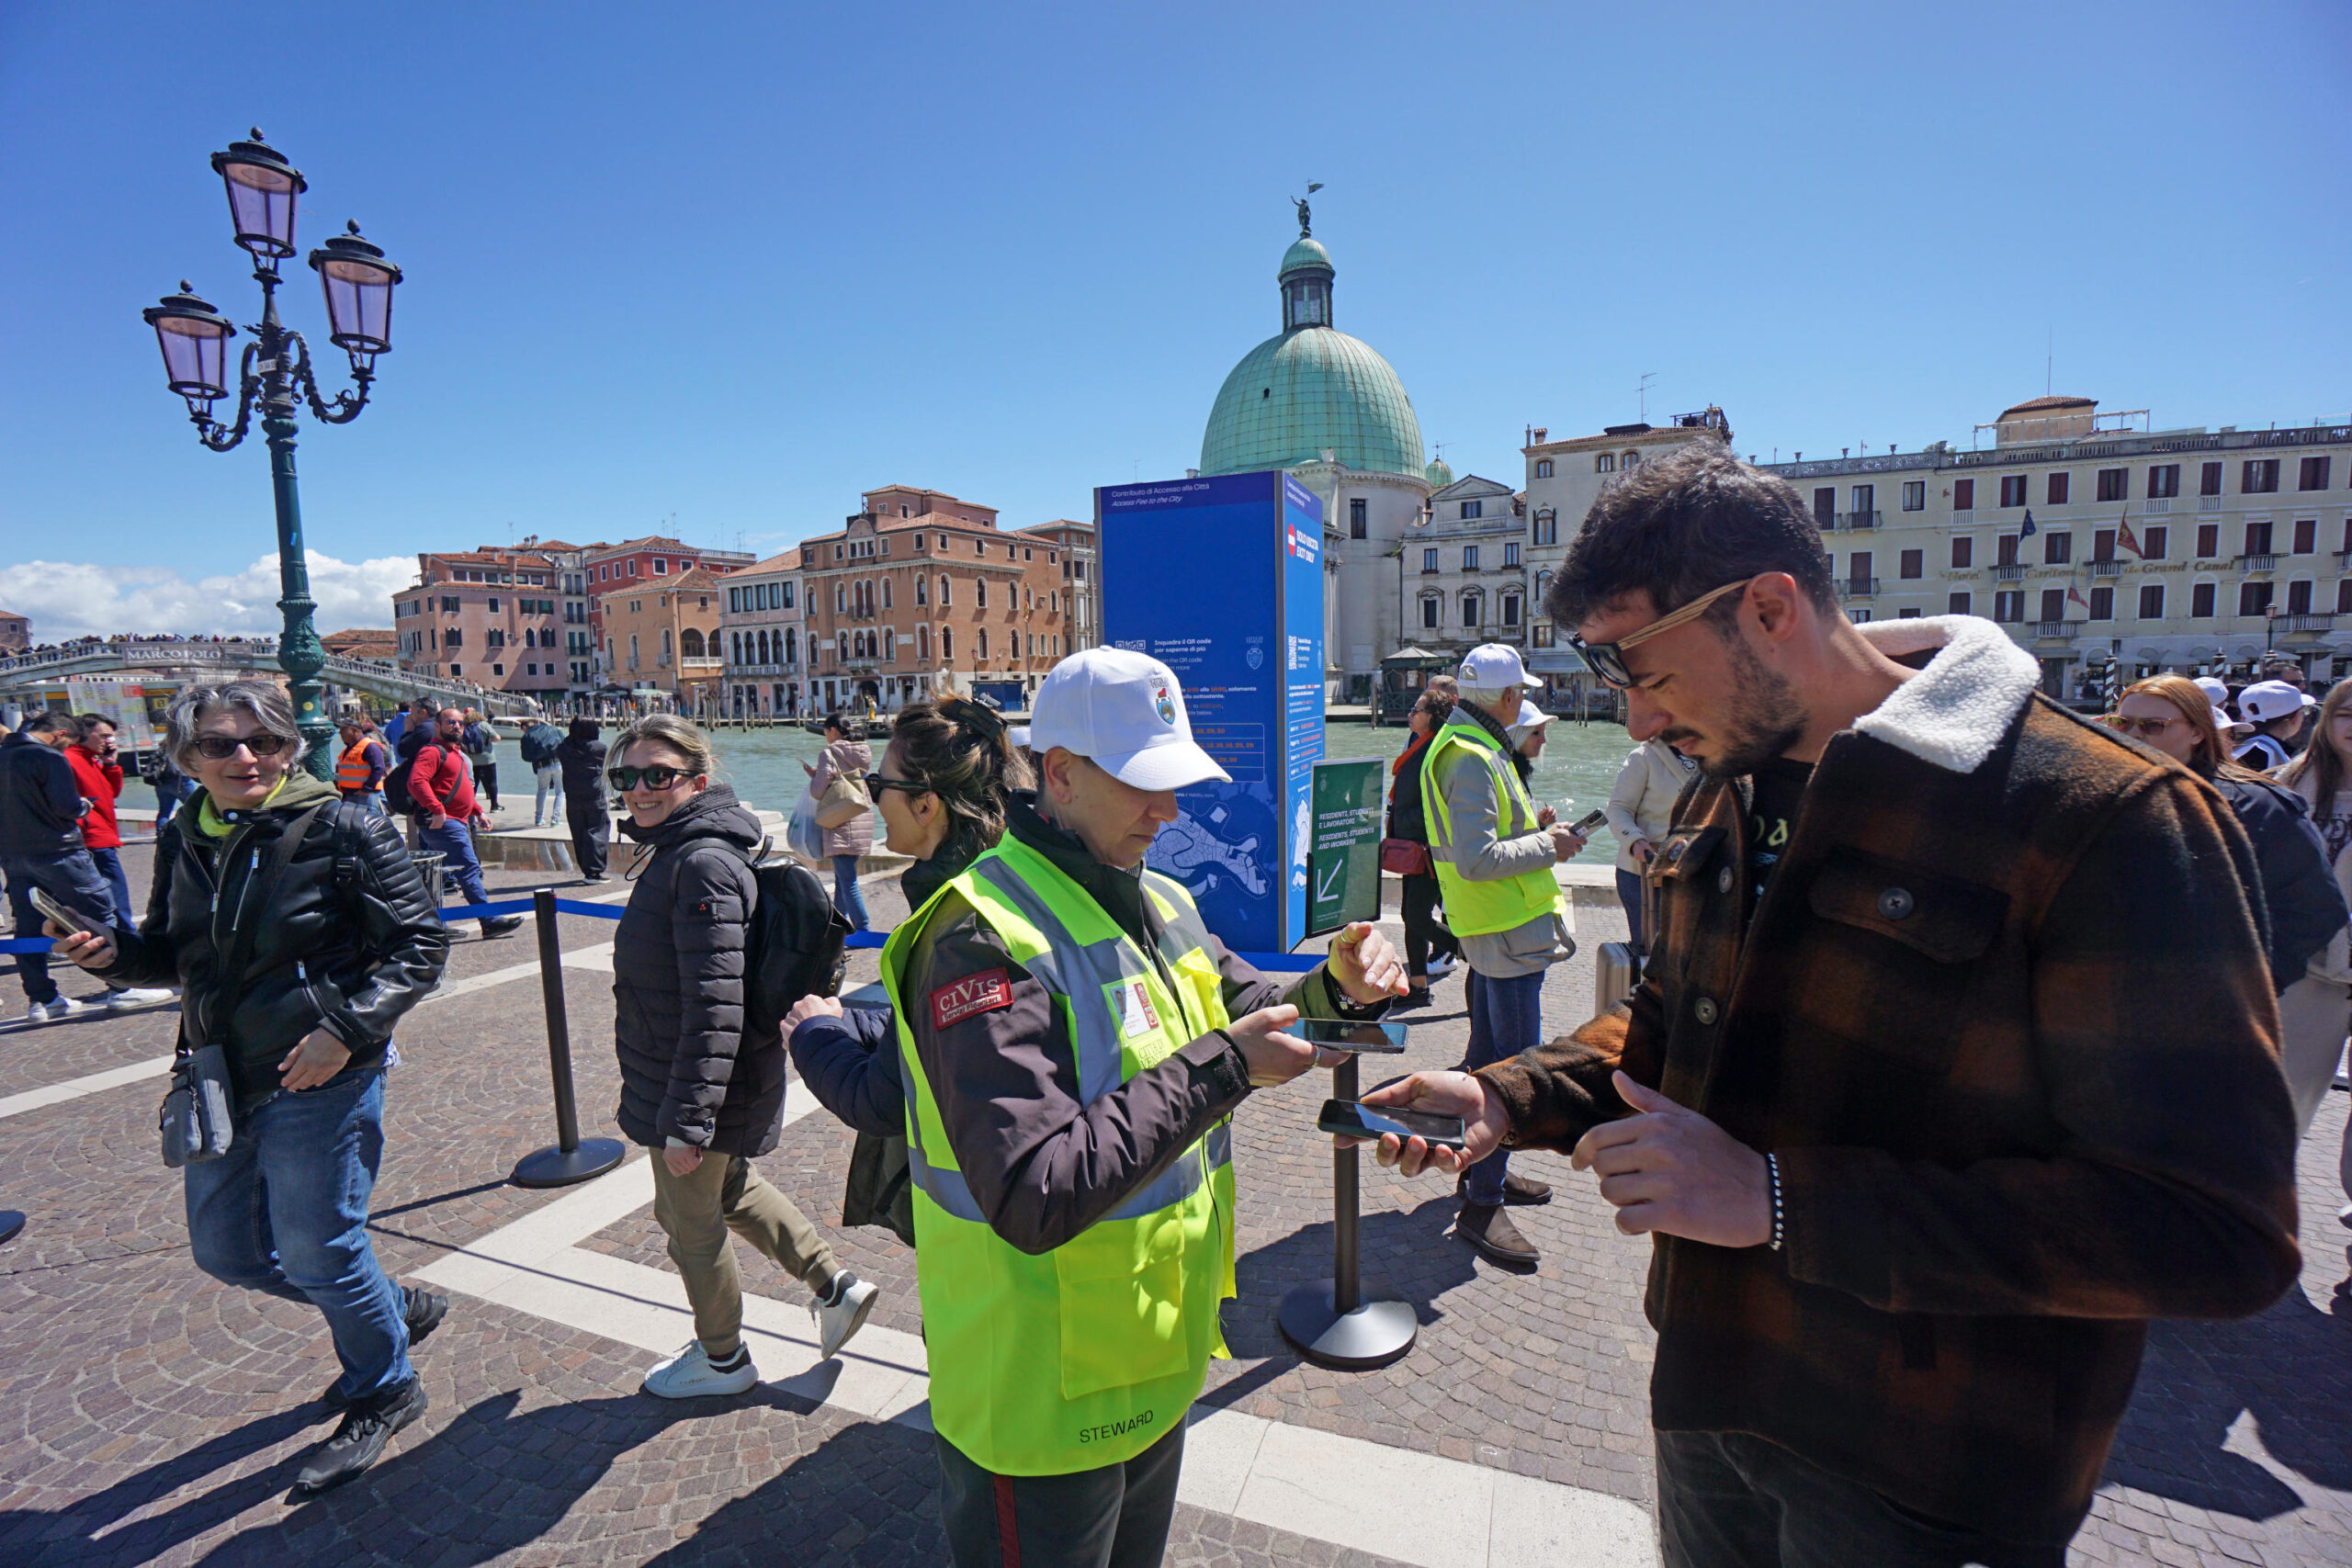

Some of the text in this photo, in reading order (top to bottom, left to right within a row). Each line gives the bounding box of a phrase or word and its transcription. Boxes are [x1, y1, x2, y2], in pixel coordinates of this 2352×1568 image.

[1112, 490, 1146, 498] Contributo
[1154, 486, 1181, 494] Accesso
[1112, 499, 1135, 507] Access
[1136, 497, 1148, 505] Fee
[1169, 495, 1183, 503] City
[2143, 561, 2188, 574] Grand
[2194, 559, 2235, 571] Canal
[127, 650, 220, 660] MARCO POLO
[1318, 807, 1374, 820] RESIDENTI, STUDENTI
[1323, 818, 1355, 829] LAVORATORI
[1318, 827, 1375, 841] RESIDENTS, STUDENTS
[1317, 838, 1356, 851] AND WORKERS
[939, 978, 1000, 1011] CIVIS
[1080, 1409, 1154, 1443] STEWARD
